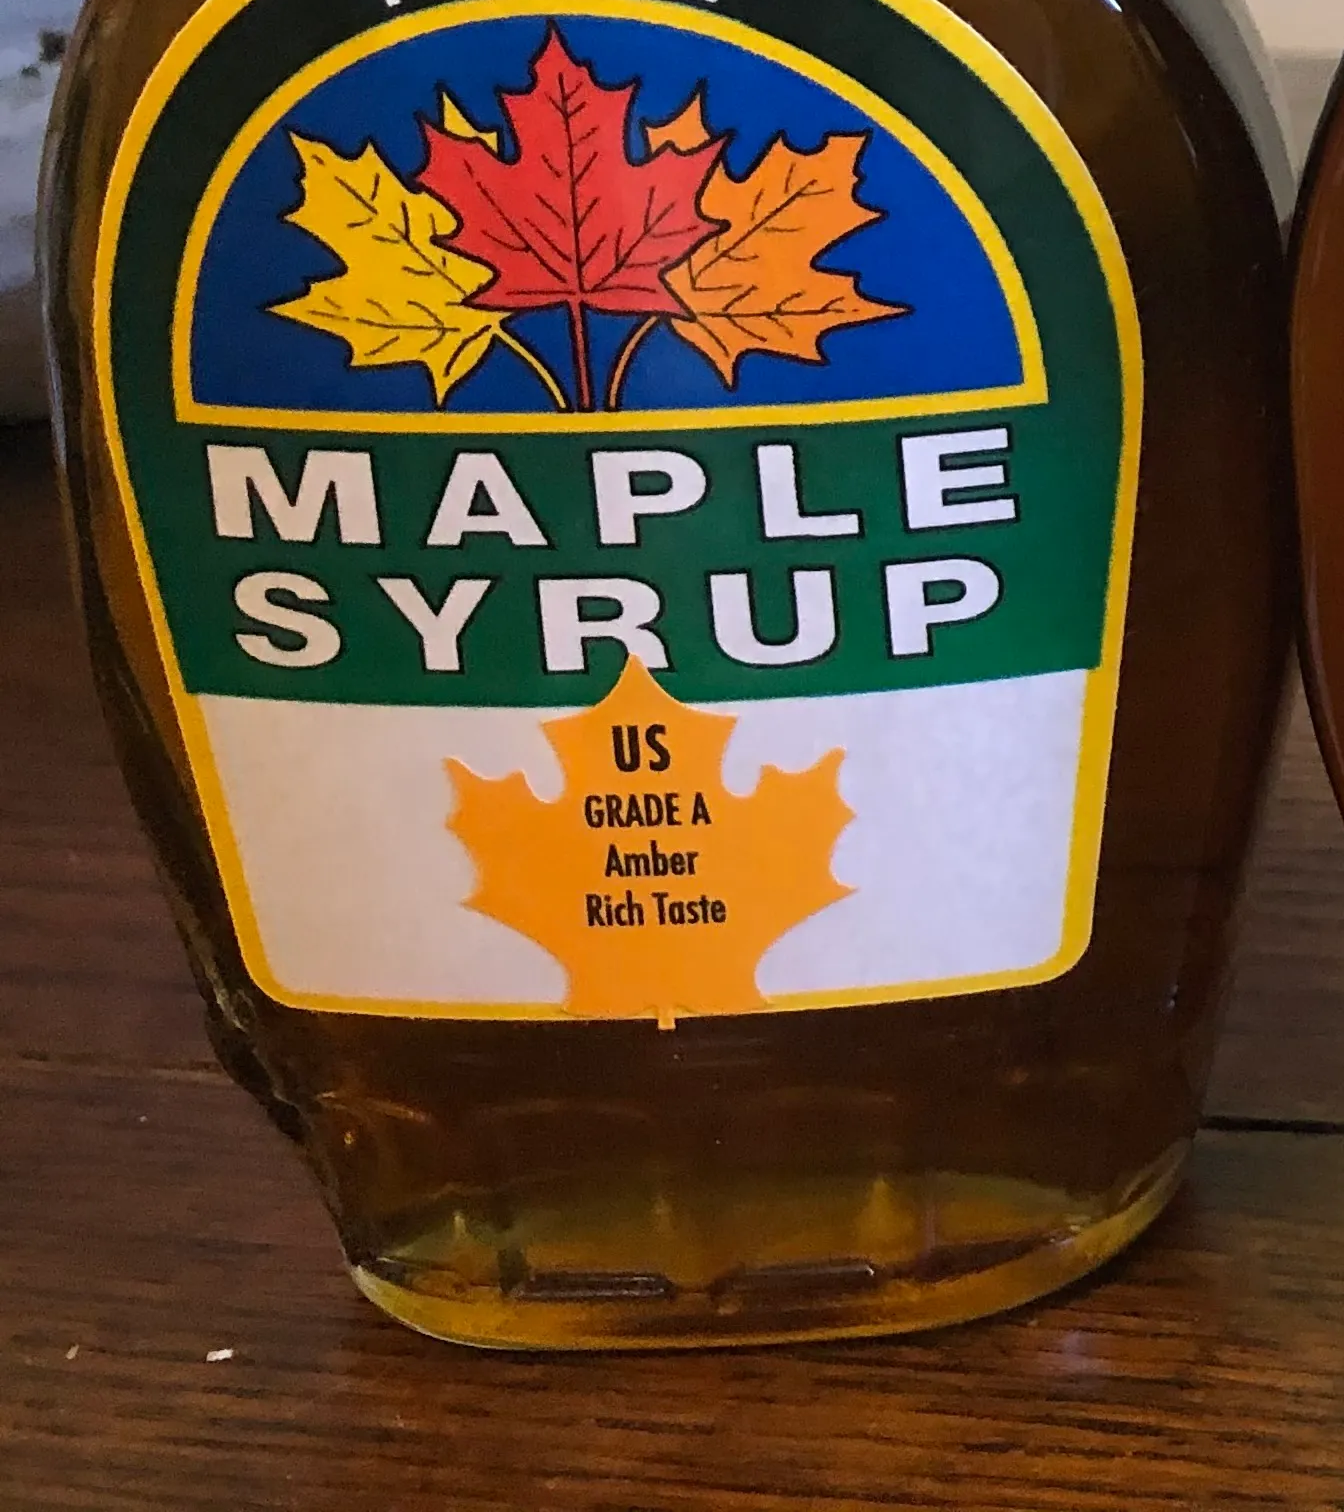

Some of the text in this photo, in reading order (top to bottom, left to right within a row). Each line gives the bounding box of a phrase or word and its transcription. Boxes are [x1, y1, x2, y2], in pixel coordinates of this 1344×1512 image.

[205, 425, 1018, 548] MAPLE
[234, 555, 1001, 676] SYRUP
[612, 723, 671, 773] US
[584, 793, 711, 829] GRADE A
[605, 844, 698, 879] Amber
[585, 891, 726, 928] Rich Taste
